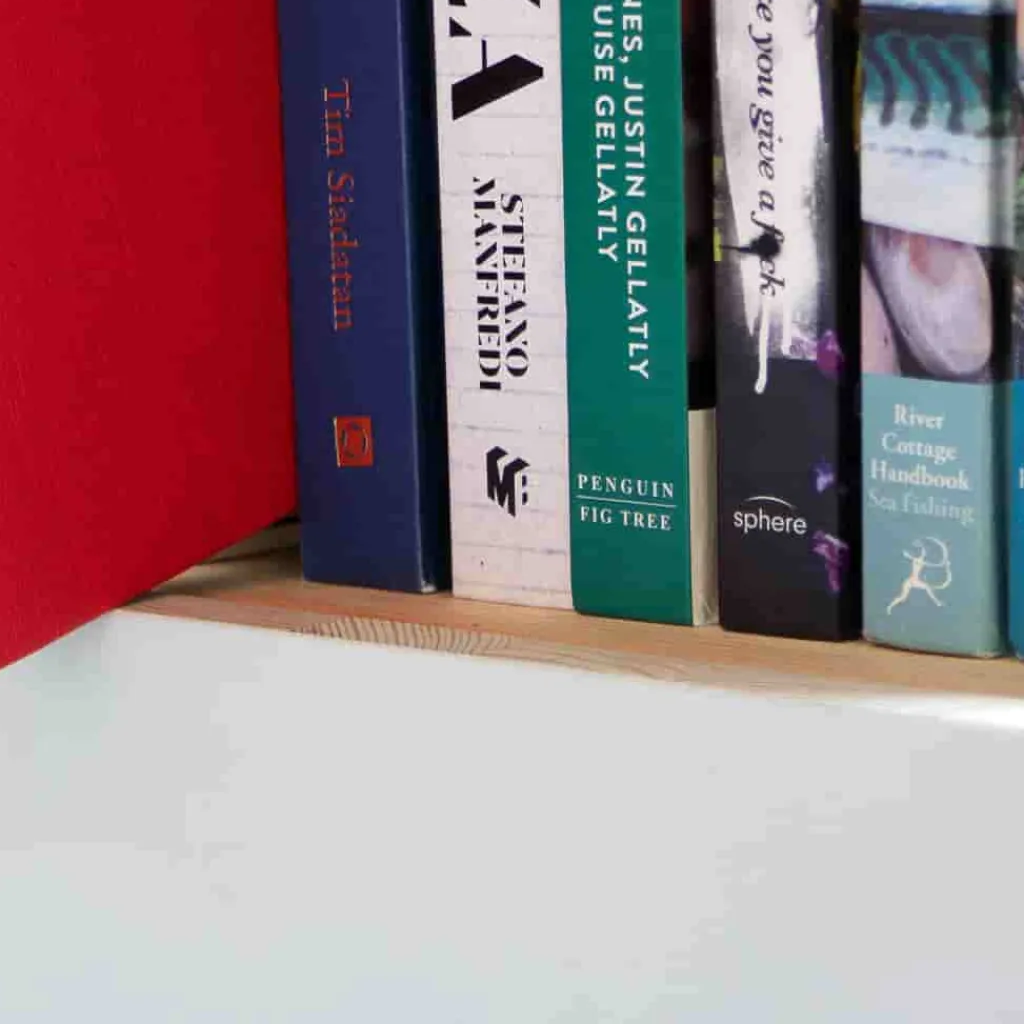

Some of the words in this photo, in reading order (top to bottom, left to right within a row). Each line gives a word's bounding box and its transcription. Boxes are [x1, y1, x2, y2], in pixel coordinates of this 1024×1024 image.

[749, 24, 774, 96] you
[322, 77, 352, 157] Tim
[623, 77, 646, 198] JUSTIN
[750, 102, 784, 180] give
[595, 94, 619, 263] GELLATLY
[758, 188, 775, 212] a
[328, 167, 359, 332] Siadatan
[473, 176, 502, 391] MANFREDI
[501, 193, 529, 378] STEFANO
[752, 211, 786, 298] fck
[626, 209, 650, 380] GELLATLY
[881, 431, 958, 465] Cottage
[893, 403, 946, 430] River
[577, 473, 675, 499] PENGUIN
[868, 487, 897, 511] Sea
[870, 457, 972, 492] Handbook
[580, 505, 612, 524] FIG
[619, 510, 672, 532] TREE
[733, 507, 808, 535] sphere
